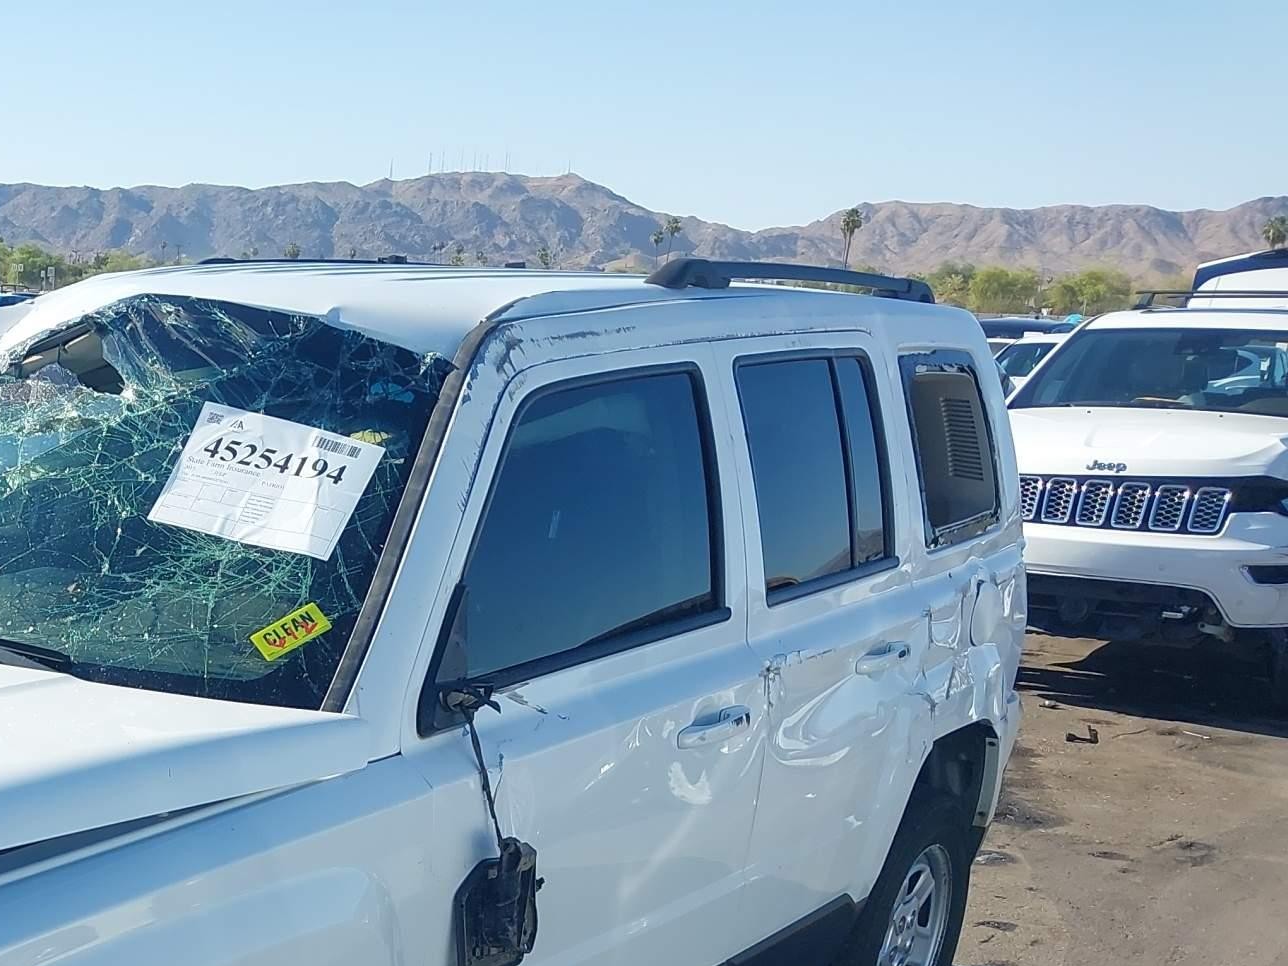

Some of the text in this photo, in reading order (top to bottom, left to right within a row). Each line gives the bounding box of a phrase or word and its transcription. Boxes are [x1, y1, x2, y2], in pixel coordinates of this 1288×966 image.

[187, 456, 205, 465] State
[206, 460, 224, 470] Farm
[226, 465, 261, 477] Insurance
[204, 437, 347, 485] 45254194
[1086, 459, 1128, 474] Jeep
[262, 610, 315, 647] CLEAN
